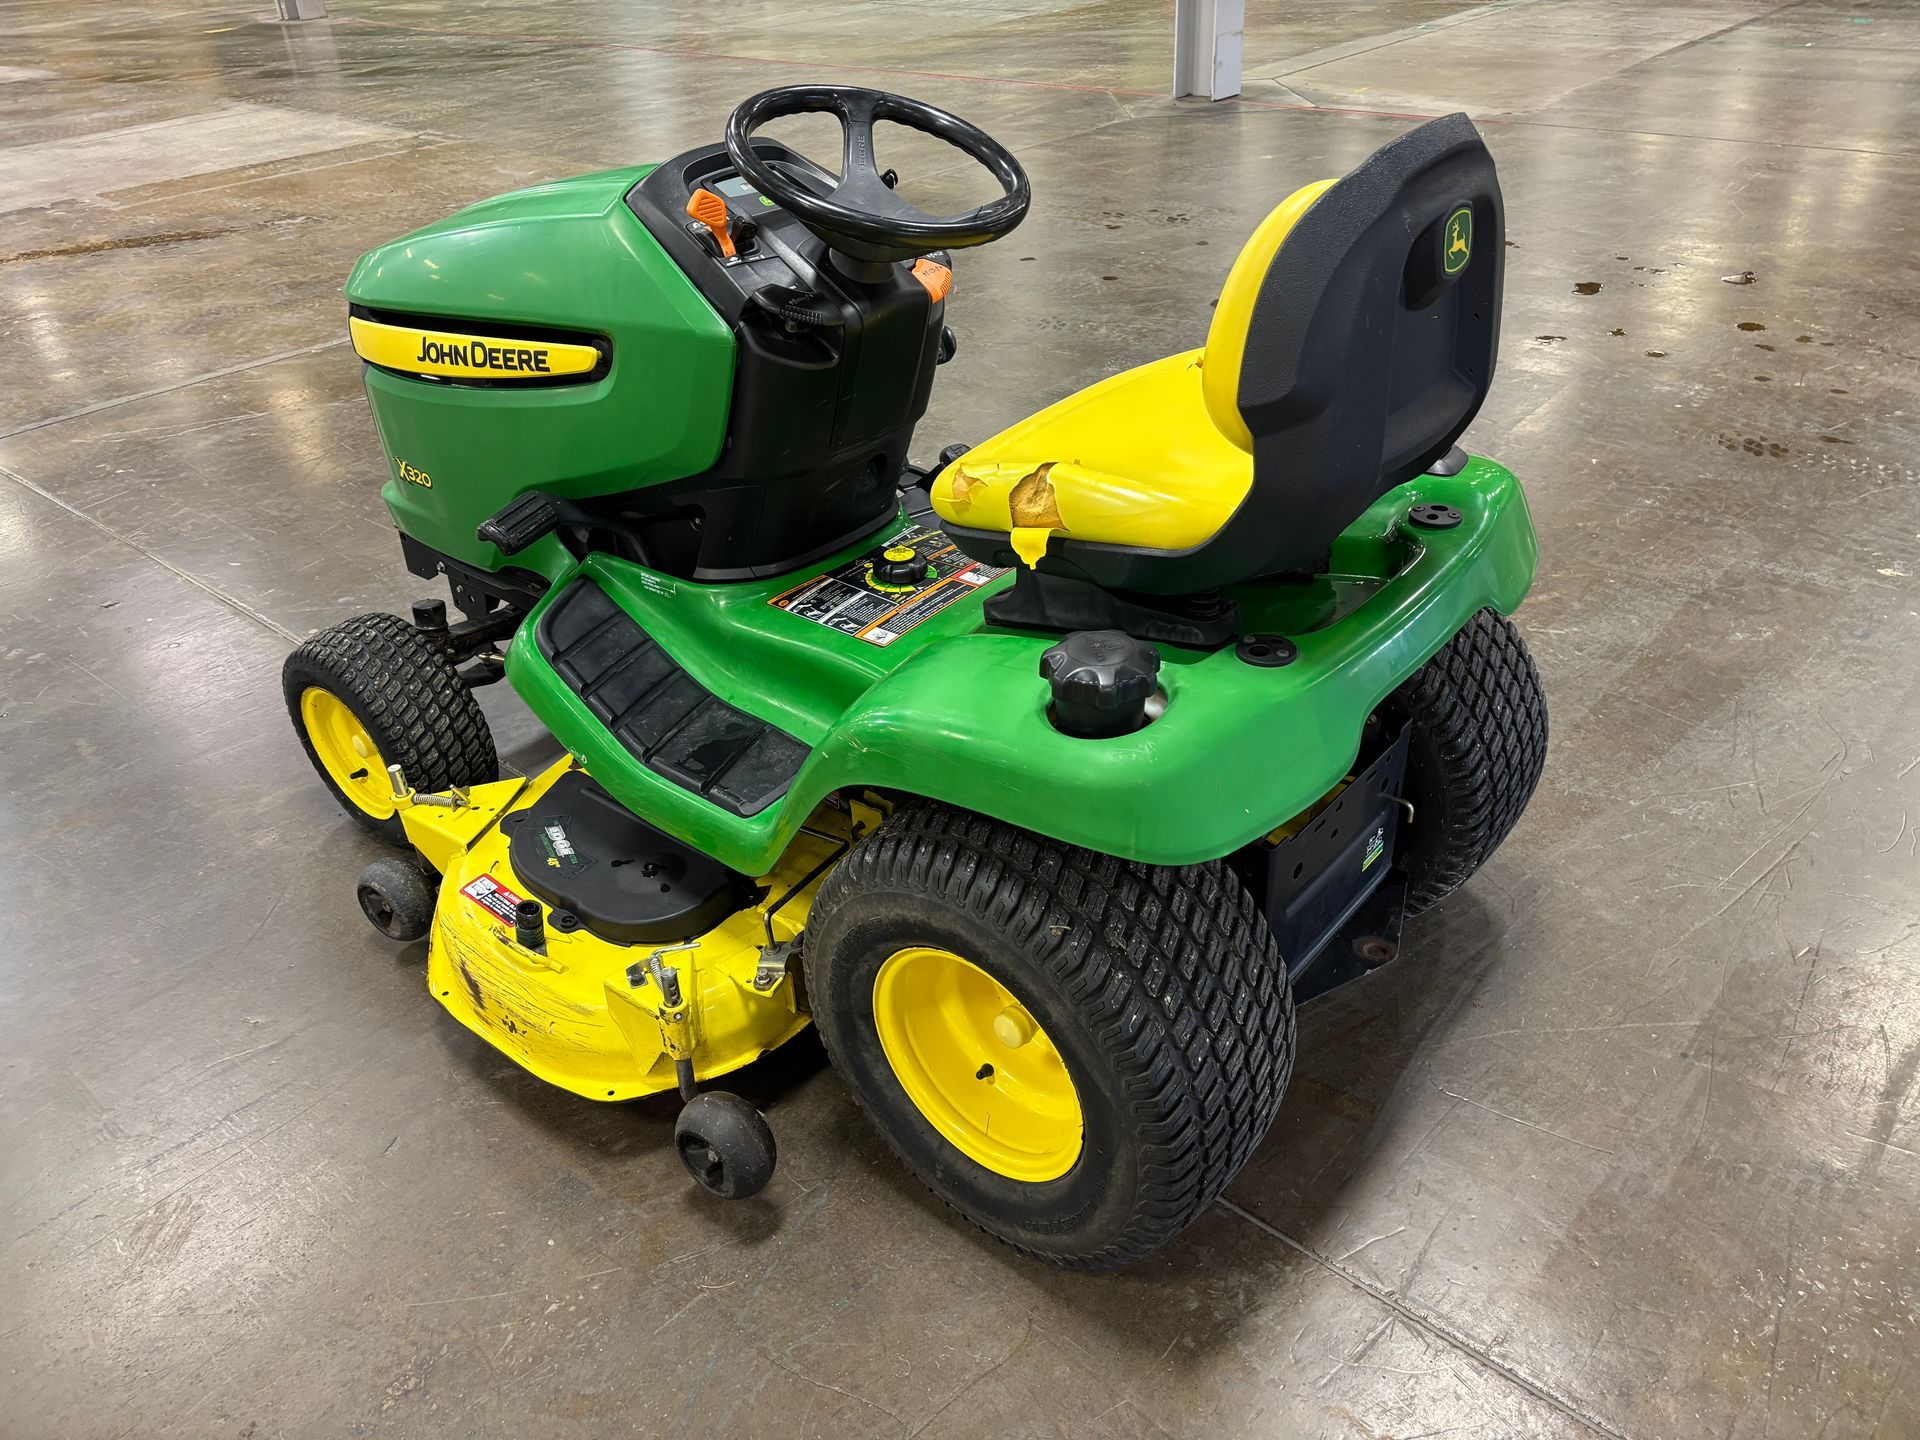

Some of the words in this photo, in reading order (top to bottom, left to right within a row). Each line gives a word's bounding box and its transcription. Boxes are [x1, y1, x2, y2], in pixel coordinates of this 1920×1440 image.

[417, 336, 468, 367] JOHN
[471, 341, 551, 372] DEERE
[395, 457, 432, 488] X320
